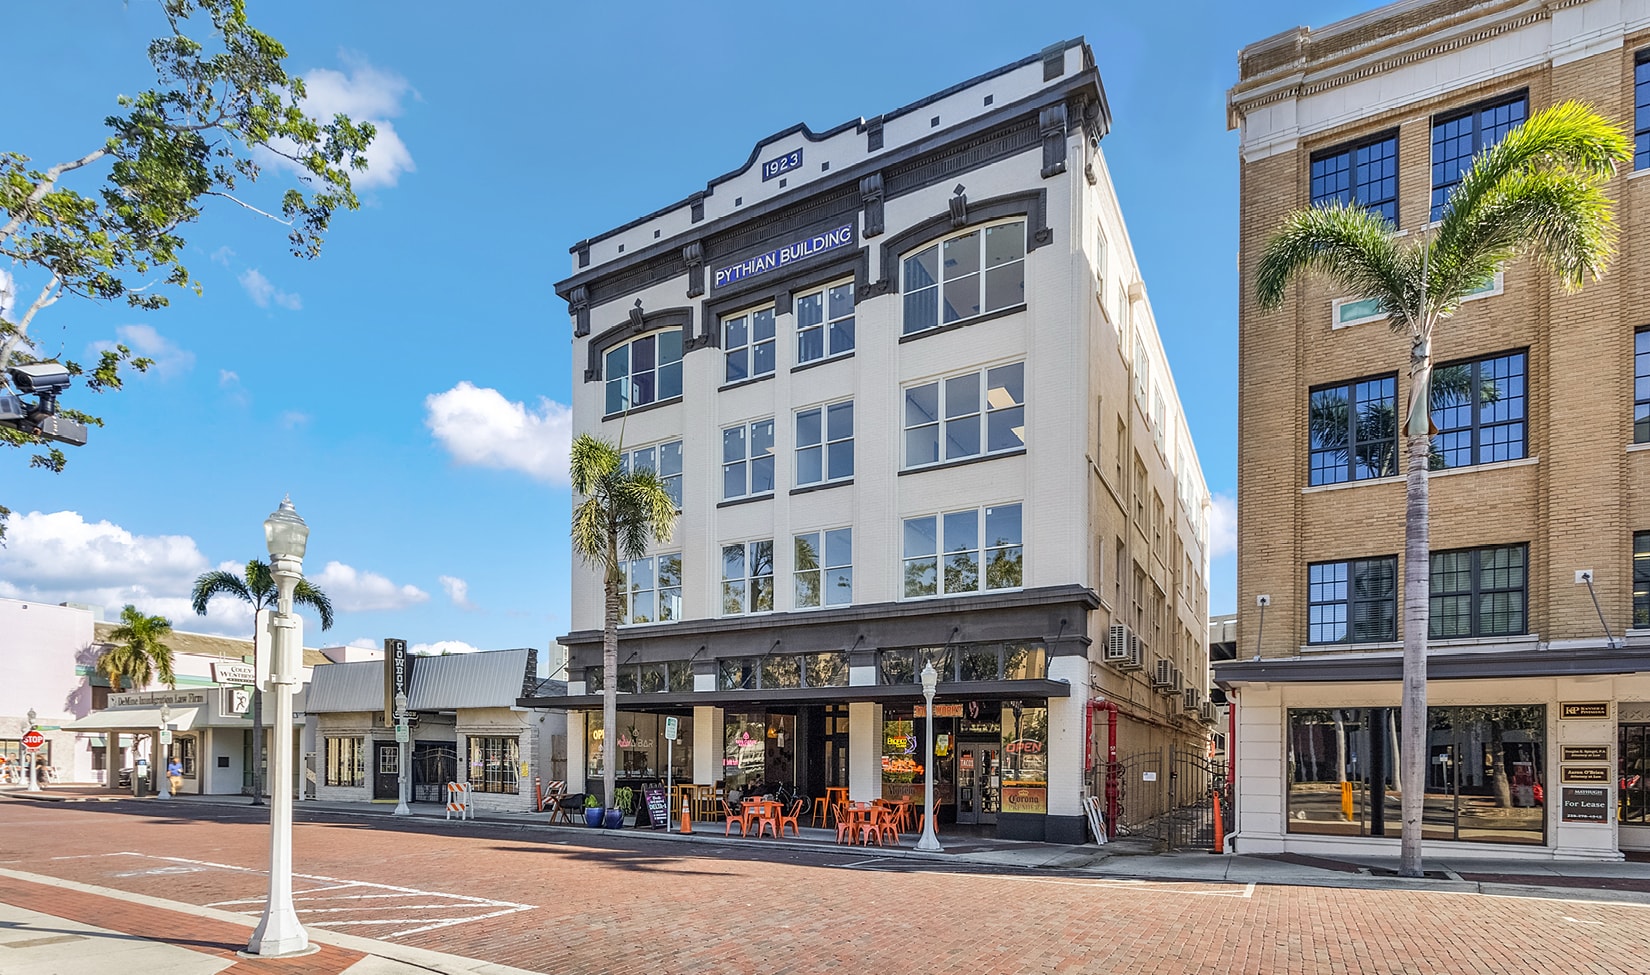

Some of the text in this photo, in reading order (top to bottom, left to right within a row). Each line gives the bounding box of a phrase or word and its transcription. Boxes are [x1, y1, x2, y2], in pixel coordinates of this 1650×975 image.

[766, 153, 799, 177] 1923
[716, 228, 851, 286] PYTHIAN BUILDING
[395, 642, 404, 691] COWBOY
[139, 694, 173, 705] Immigration
[175, 694, 187, 704] Law
[188, 693, 204, 703] Firm
[23, 735, 43, 743] STOP
[637, 739, 654, 748] BAR
[1005, 742, 1042, 753] OPEN
[1008, 794, 1039, 804] Corona
